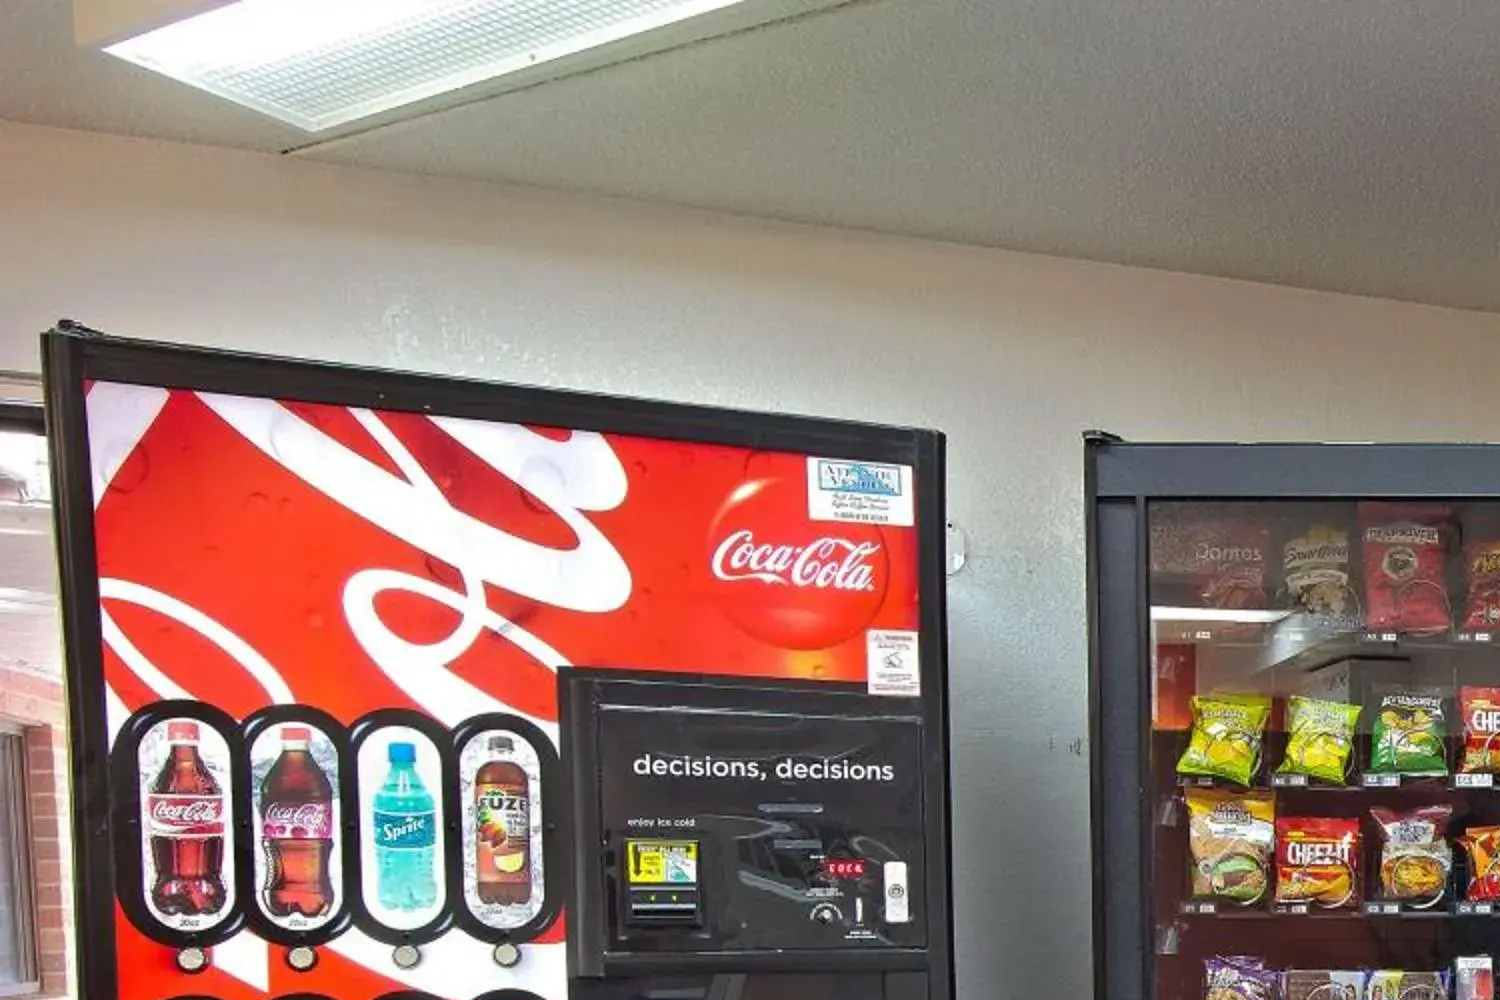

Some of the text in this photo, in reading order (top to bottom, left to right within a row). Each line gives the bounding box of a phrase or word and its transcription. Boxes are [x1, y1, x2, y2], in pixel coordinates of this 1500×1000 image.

[632, 754, 894, 781] decisions, decisions
[382, 817, 426, 842] Sprite
[1287, 832, 1352, 865] CHEEZ-IT
